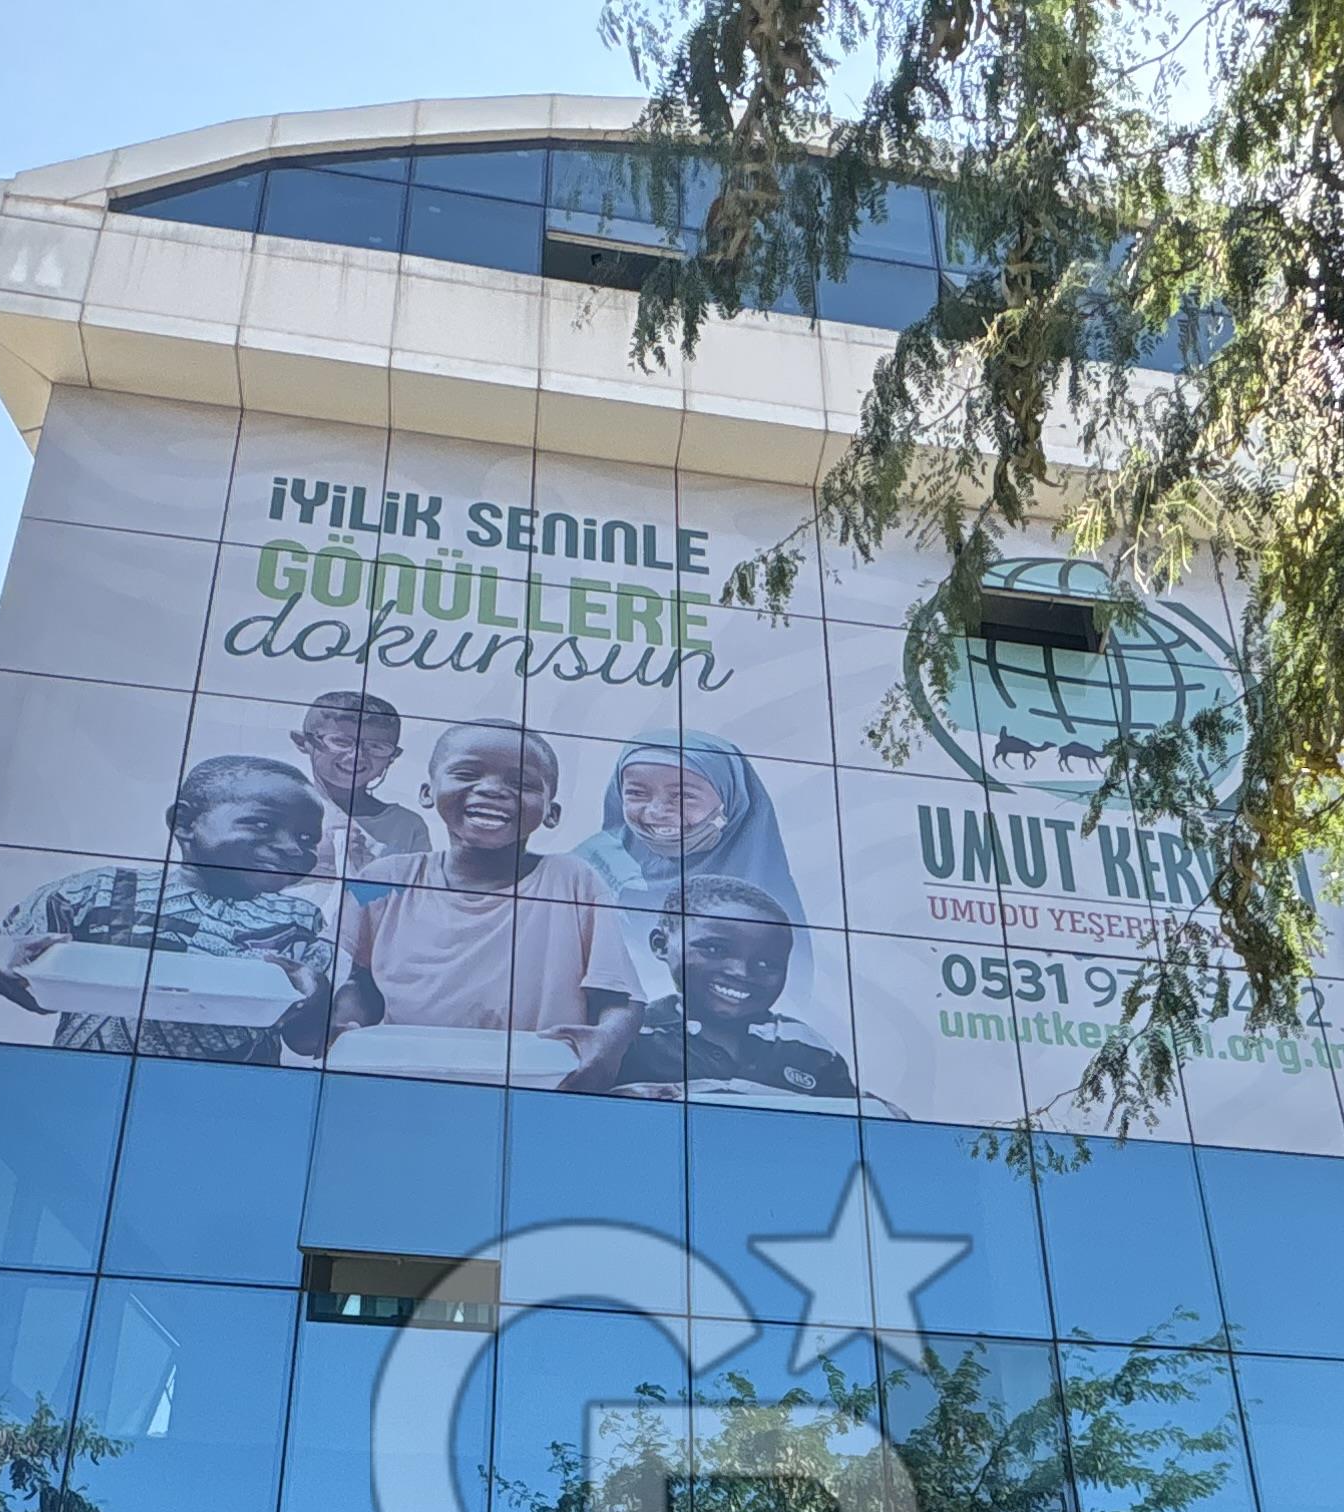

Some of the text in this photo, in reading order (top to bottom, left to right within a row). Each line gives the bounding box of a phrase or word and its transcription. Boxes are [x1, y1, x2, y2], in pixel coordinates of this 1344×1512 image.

[256, 533, 713, 651] GÖNÜLLERE
[223, 591, 734, 692] dokunsun
[917, 804, 1077, 893] UMUT
[927, 896, 1040, 929] UMUDU
[941, 953, 1069, 1005] 0531
